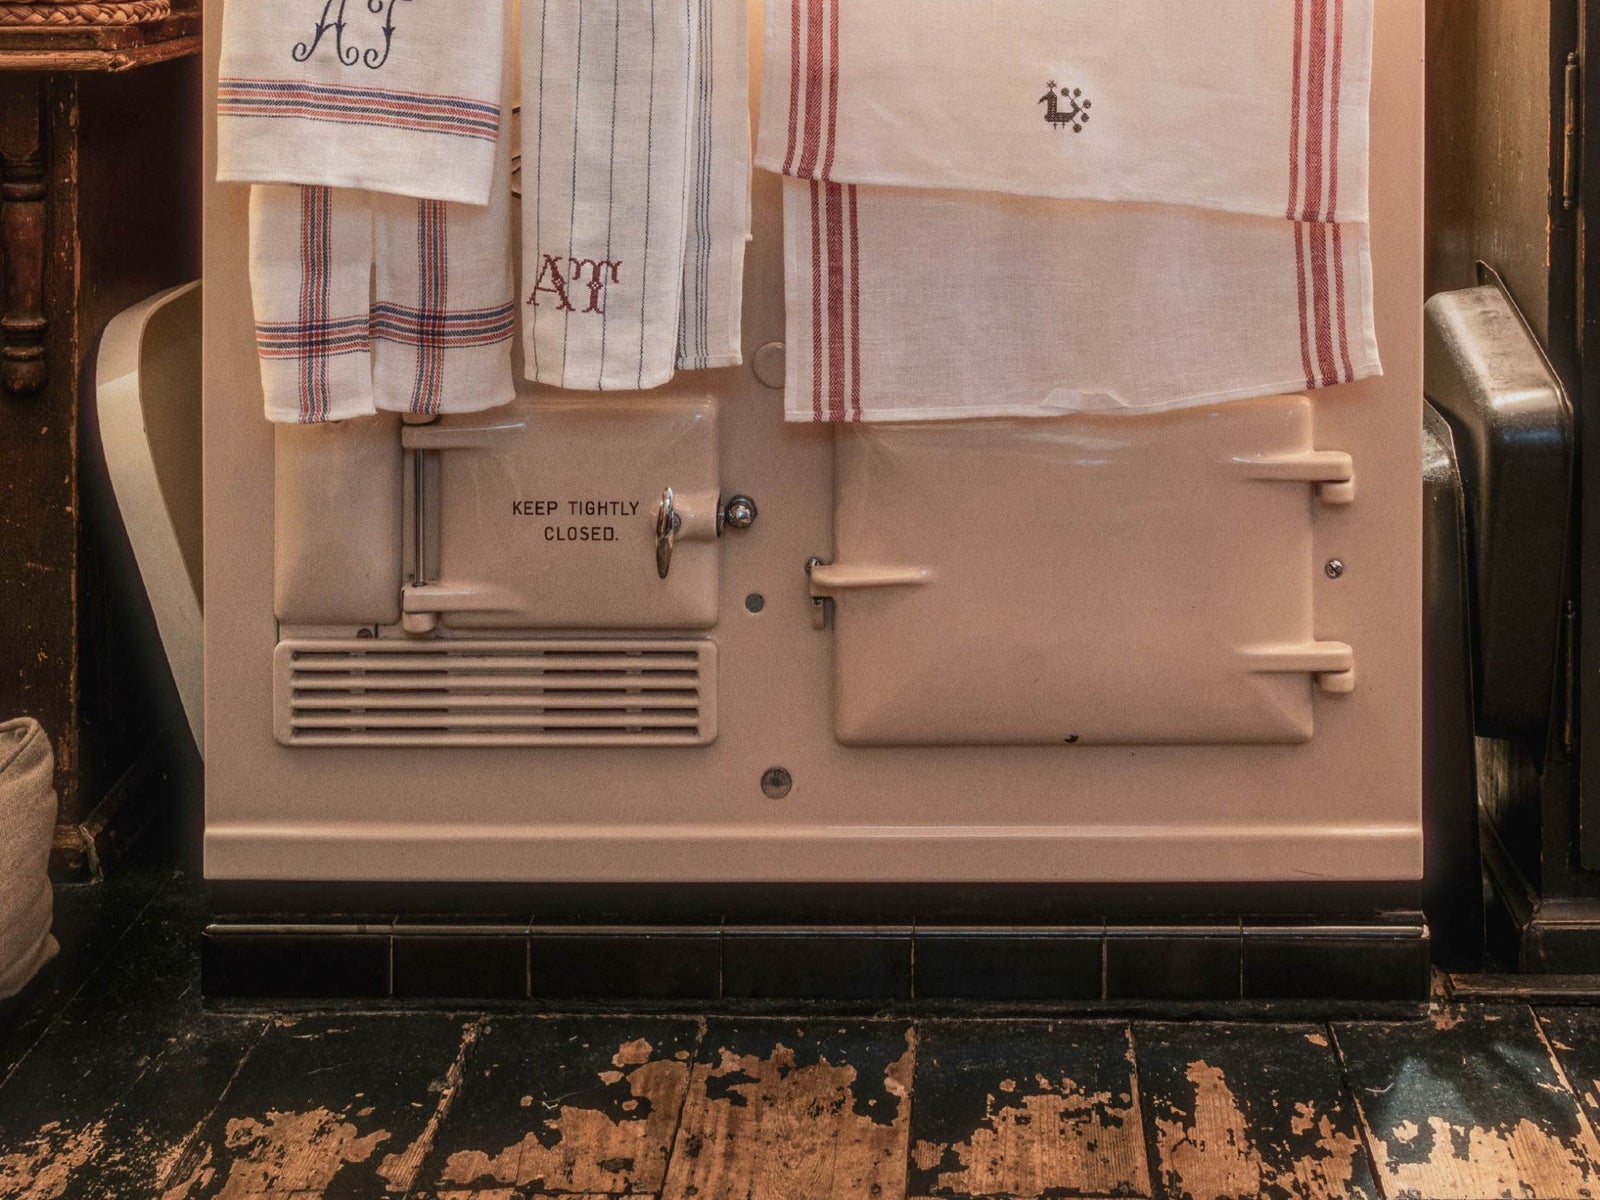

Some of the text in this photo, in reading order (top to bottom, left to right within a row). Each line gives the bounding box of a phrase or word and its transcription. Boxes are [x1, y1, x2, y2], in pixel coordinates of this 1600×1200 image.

[526, 253, 623, 314] AT
[511, 500, 640, 517] KEEP TIGHTLY
[543, 525, 619, 542] CLOSED.
